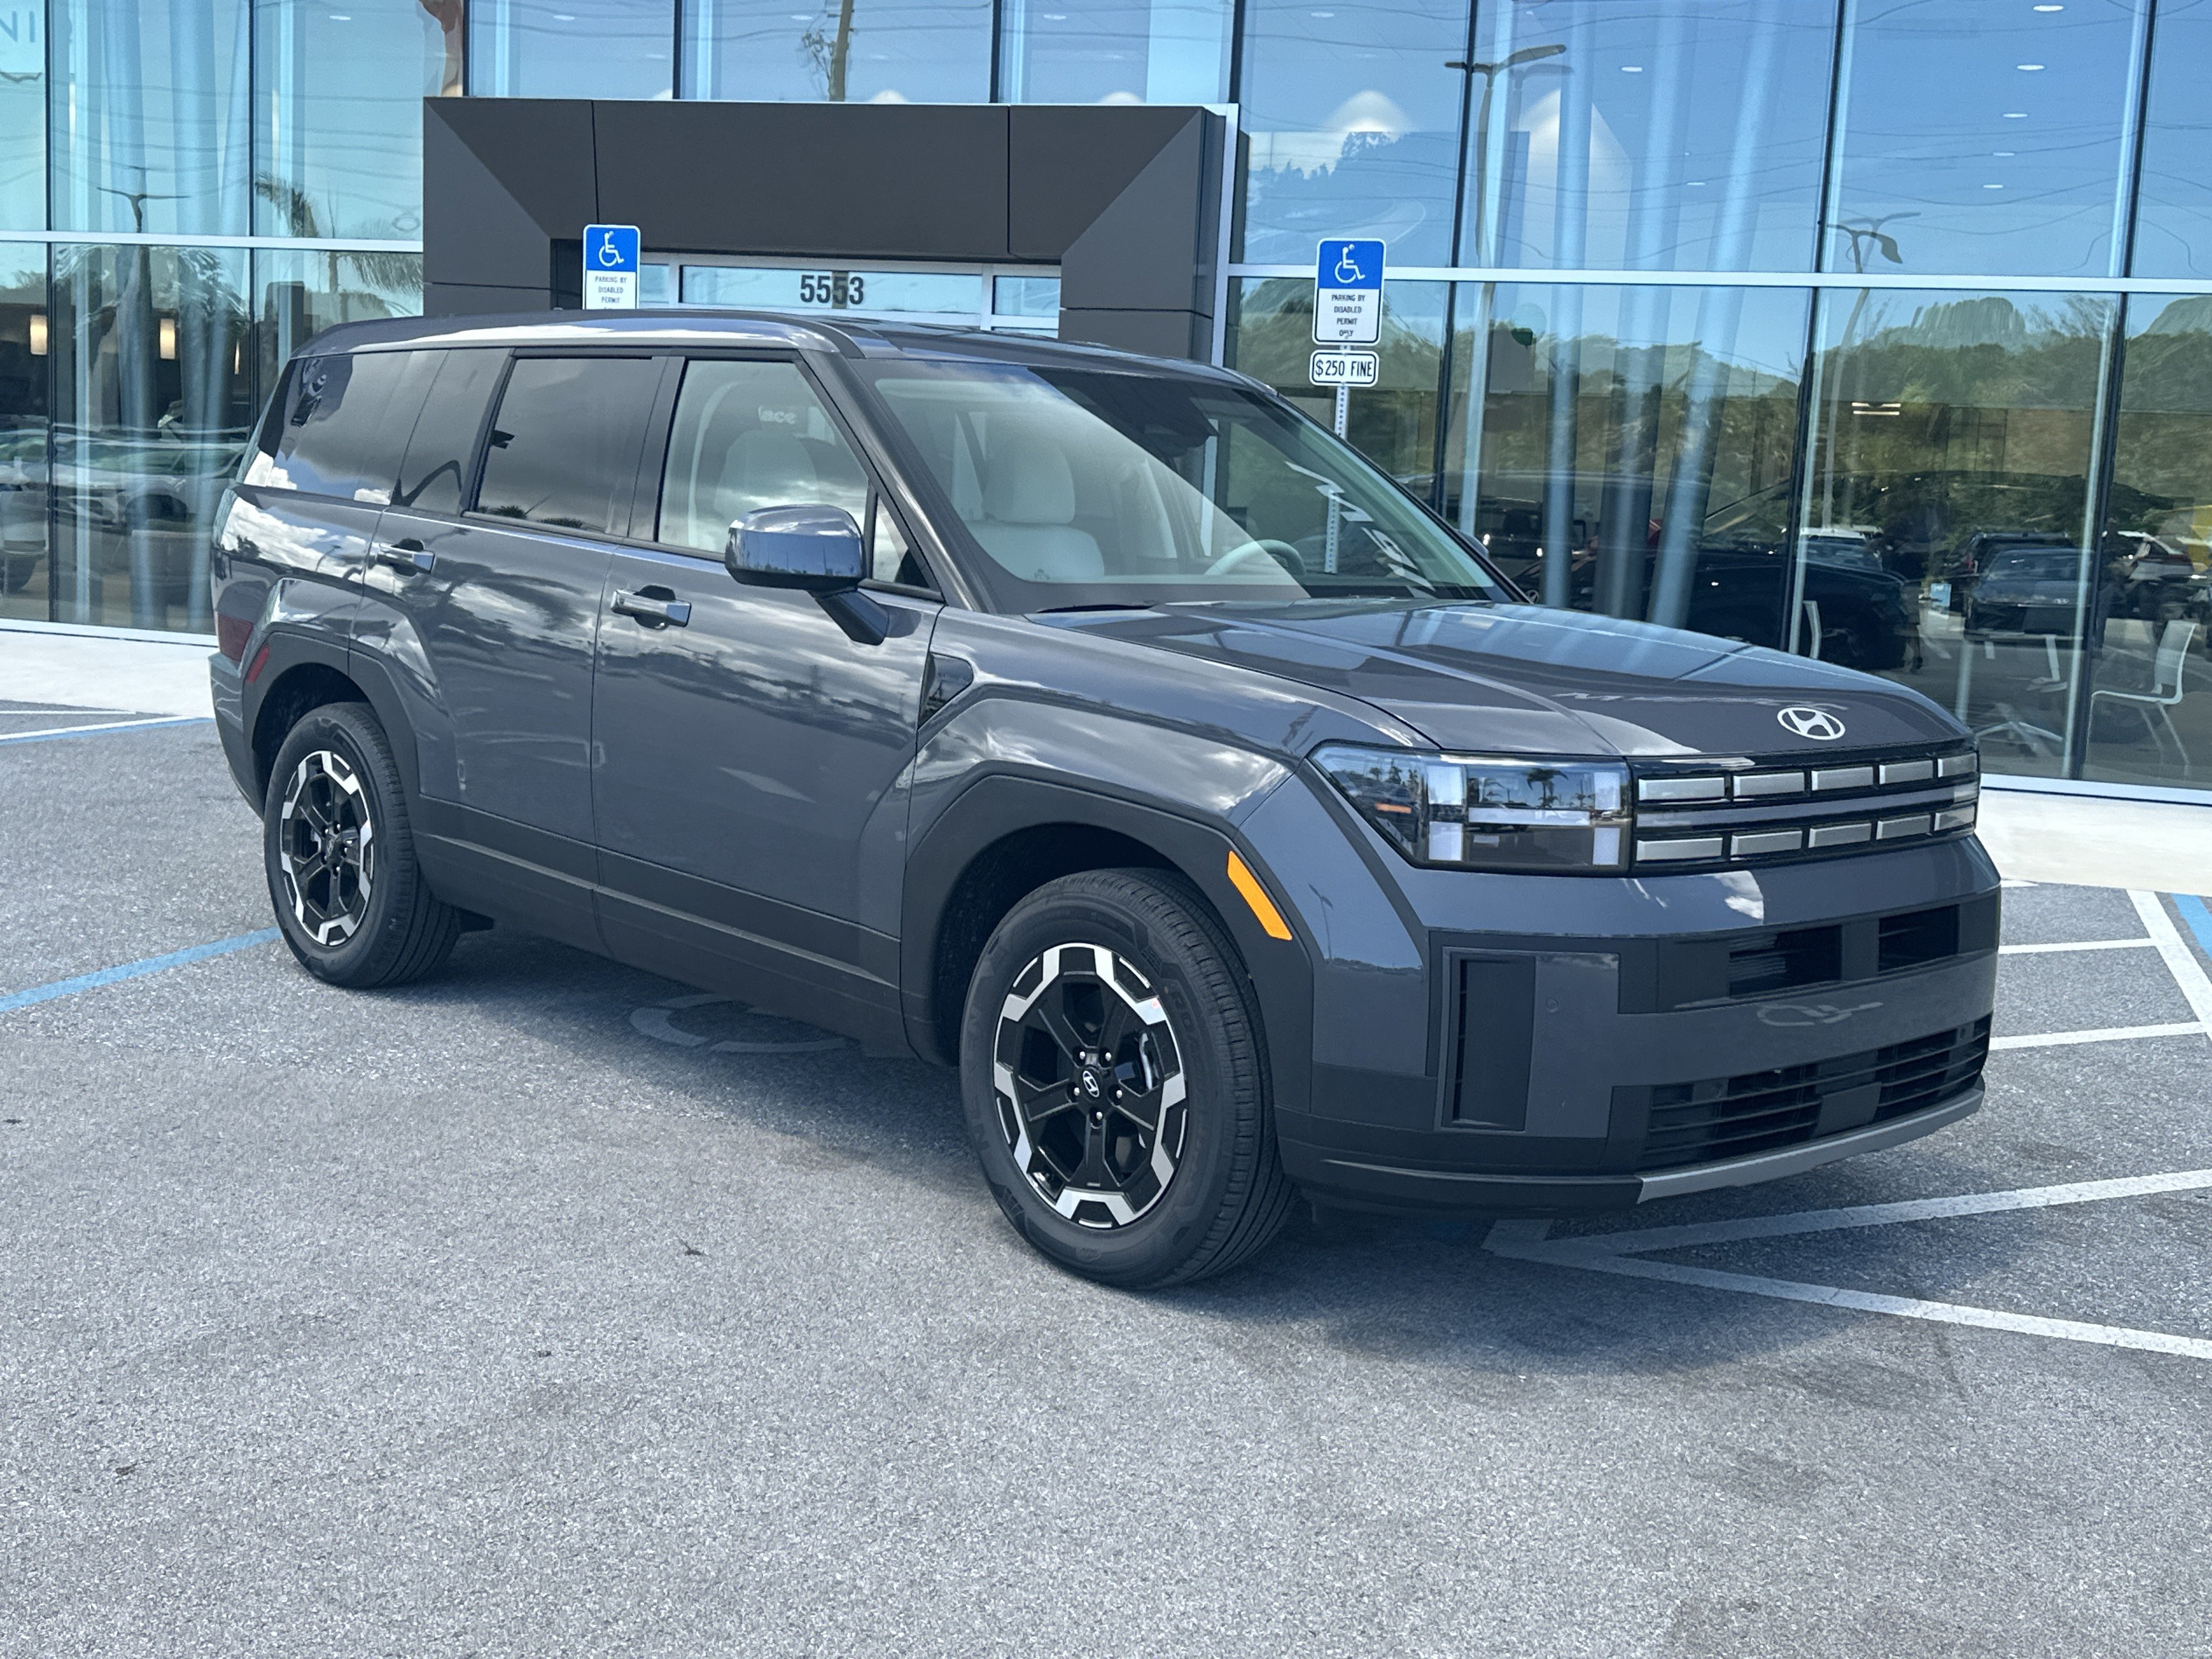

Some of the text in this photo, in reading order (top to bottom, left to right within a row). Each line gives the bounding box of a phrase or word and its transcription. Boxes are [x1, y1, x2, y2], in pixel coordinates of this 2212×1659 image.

[800, 274, 864, 304] 5553
[1316, 359, 1373, 377] $250 FINE
